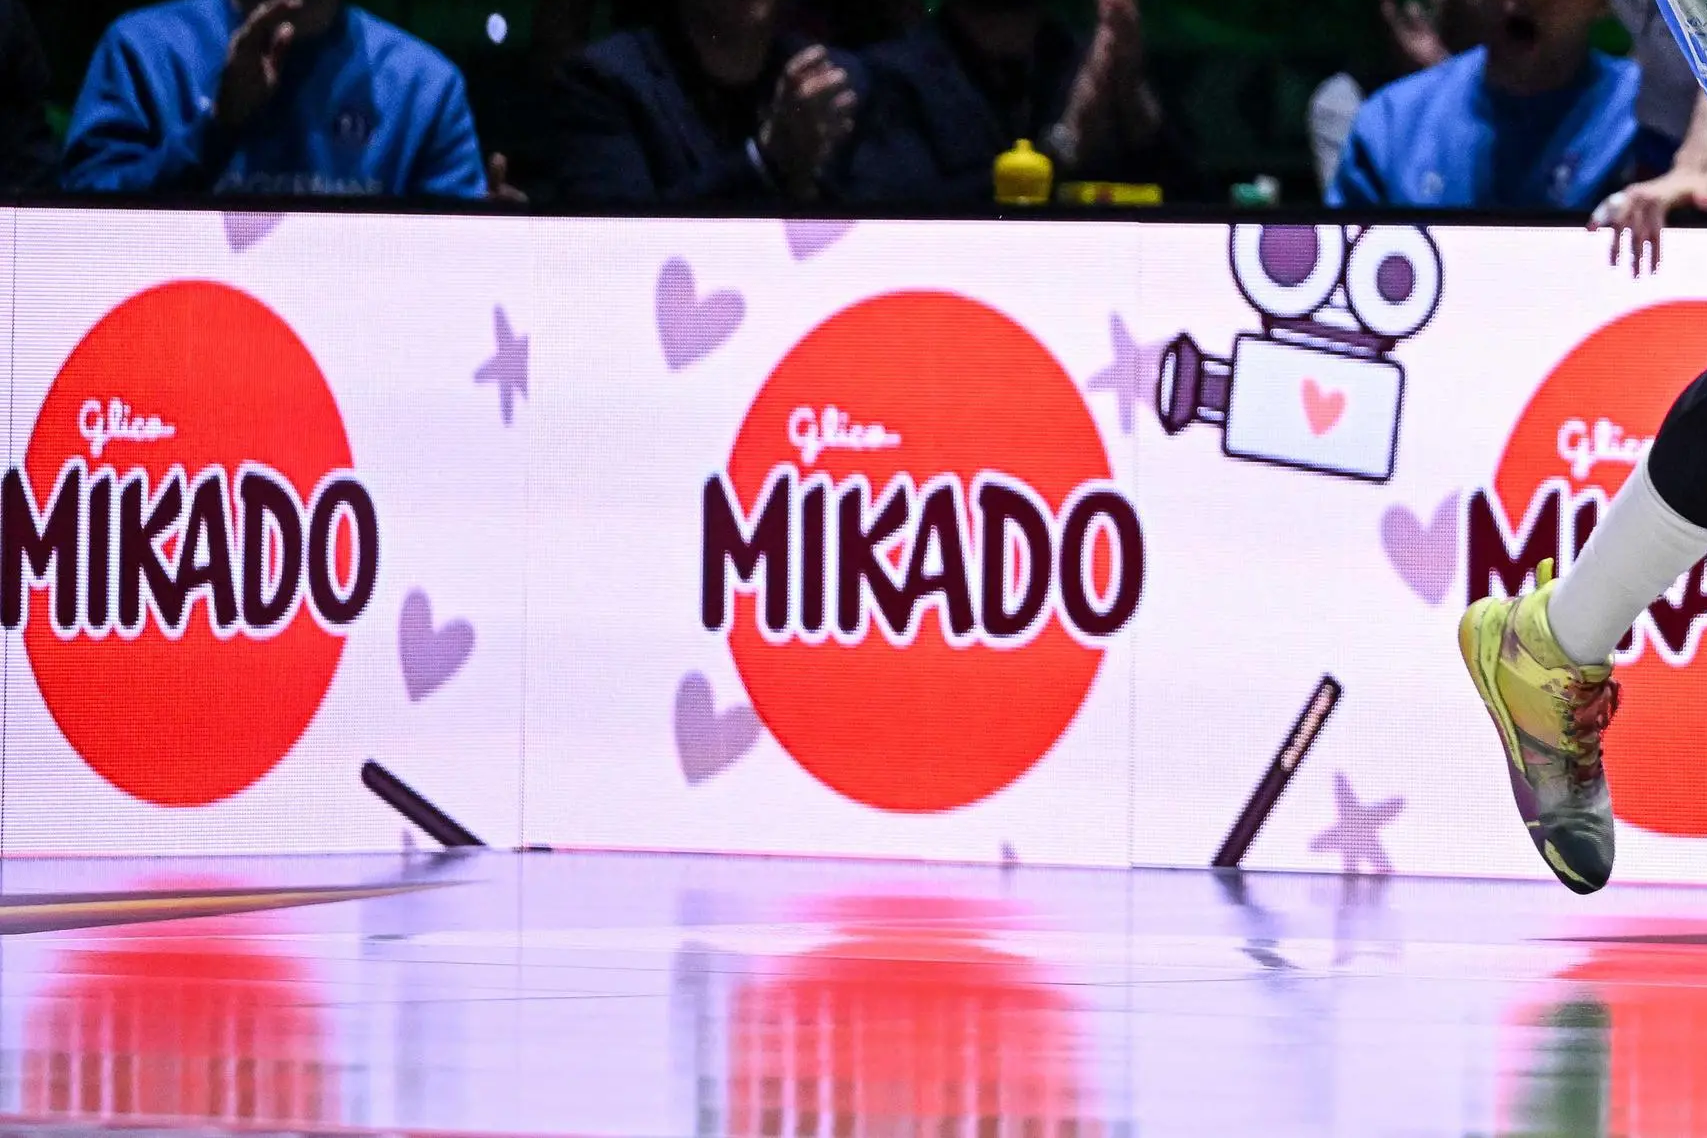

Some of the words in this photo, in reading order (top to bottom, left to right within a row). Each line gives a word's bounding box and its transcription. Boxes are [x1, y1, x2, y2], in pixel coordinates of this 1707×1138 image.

[79, 397, 177, 459] Glico
[787, 405, 902, 466] Glico
[0, 463, 379, 630] MIKADO
[700, 471, 1147, 639] MIKADO
